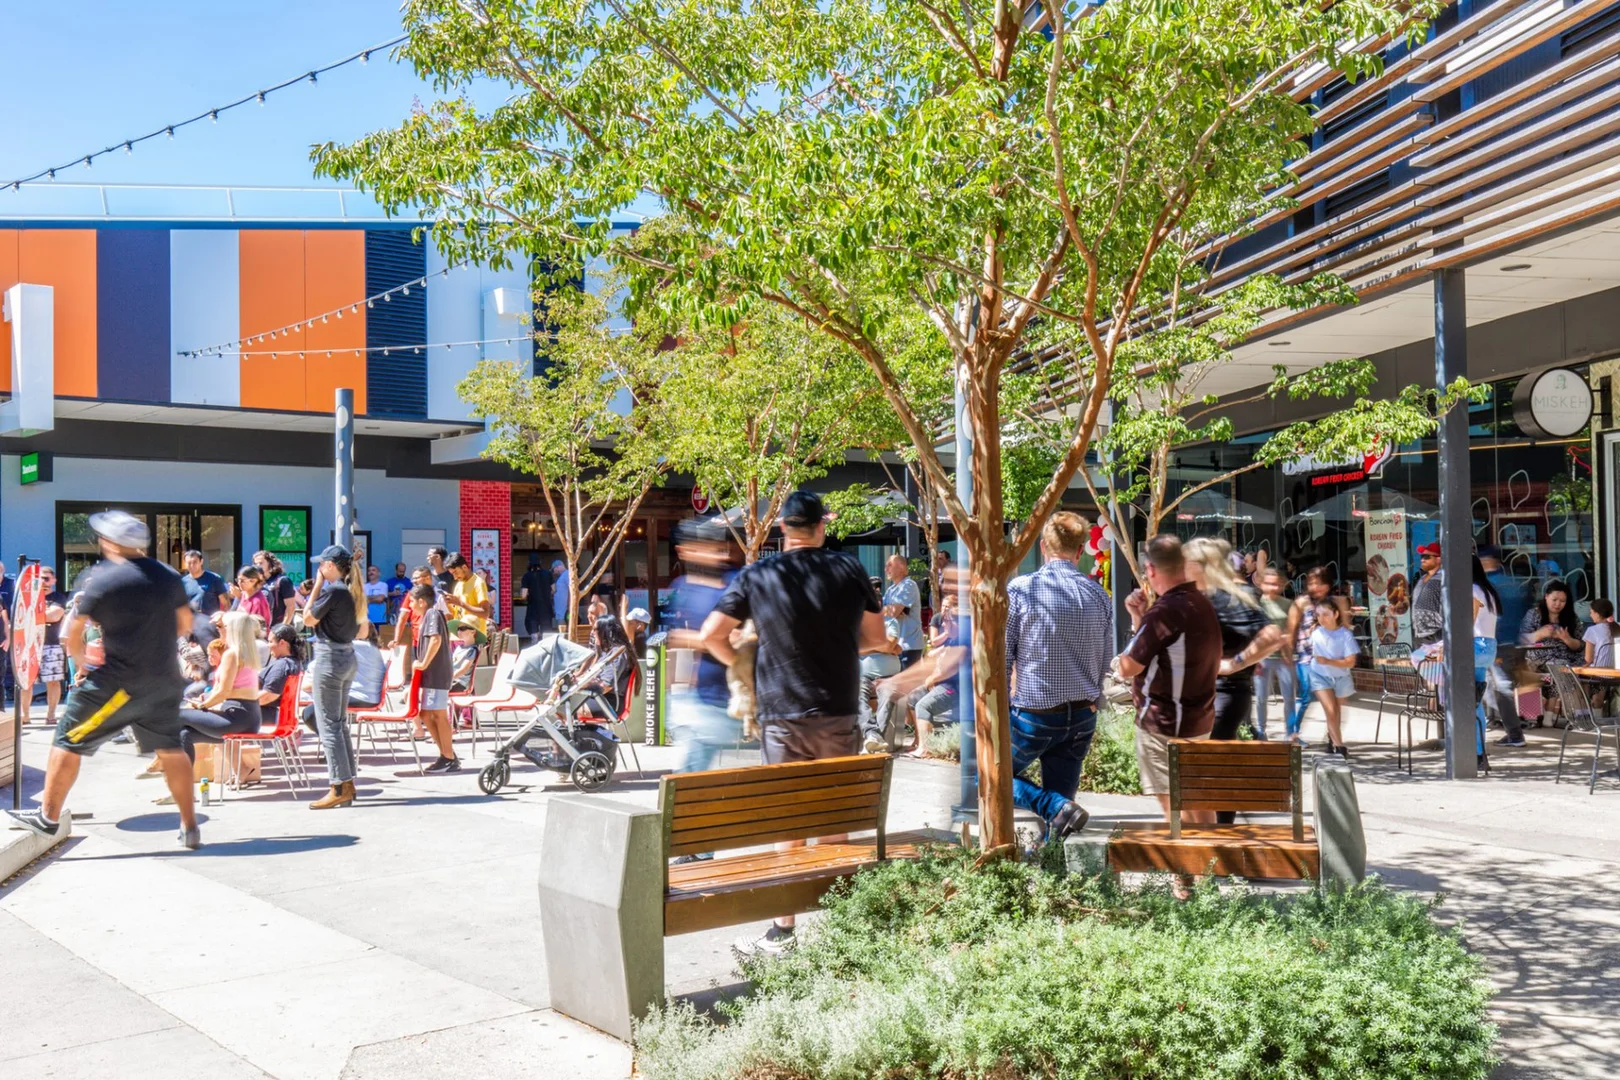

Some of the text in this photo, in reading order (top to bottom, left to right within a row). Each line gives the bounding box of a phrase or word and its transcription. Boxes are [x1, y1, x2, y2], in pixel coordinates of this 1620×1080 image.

[1534, 395, 1588, 409] MISKEH
[645, 669, 655, 745] SMOKE HERE
